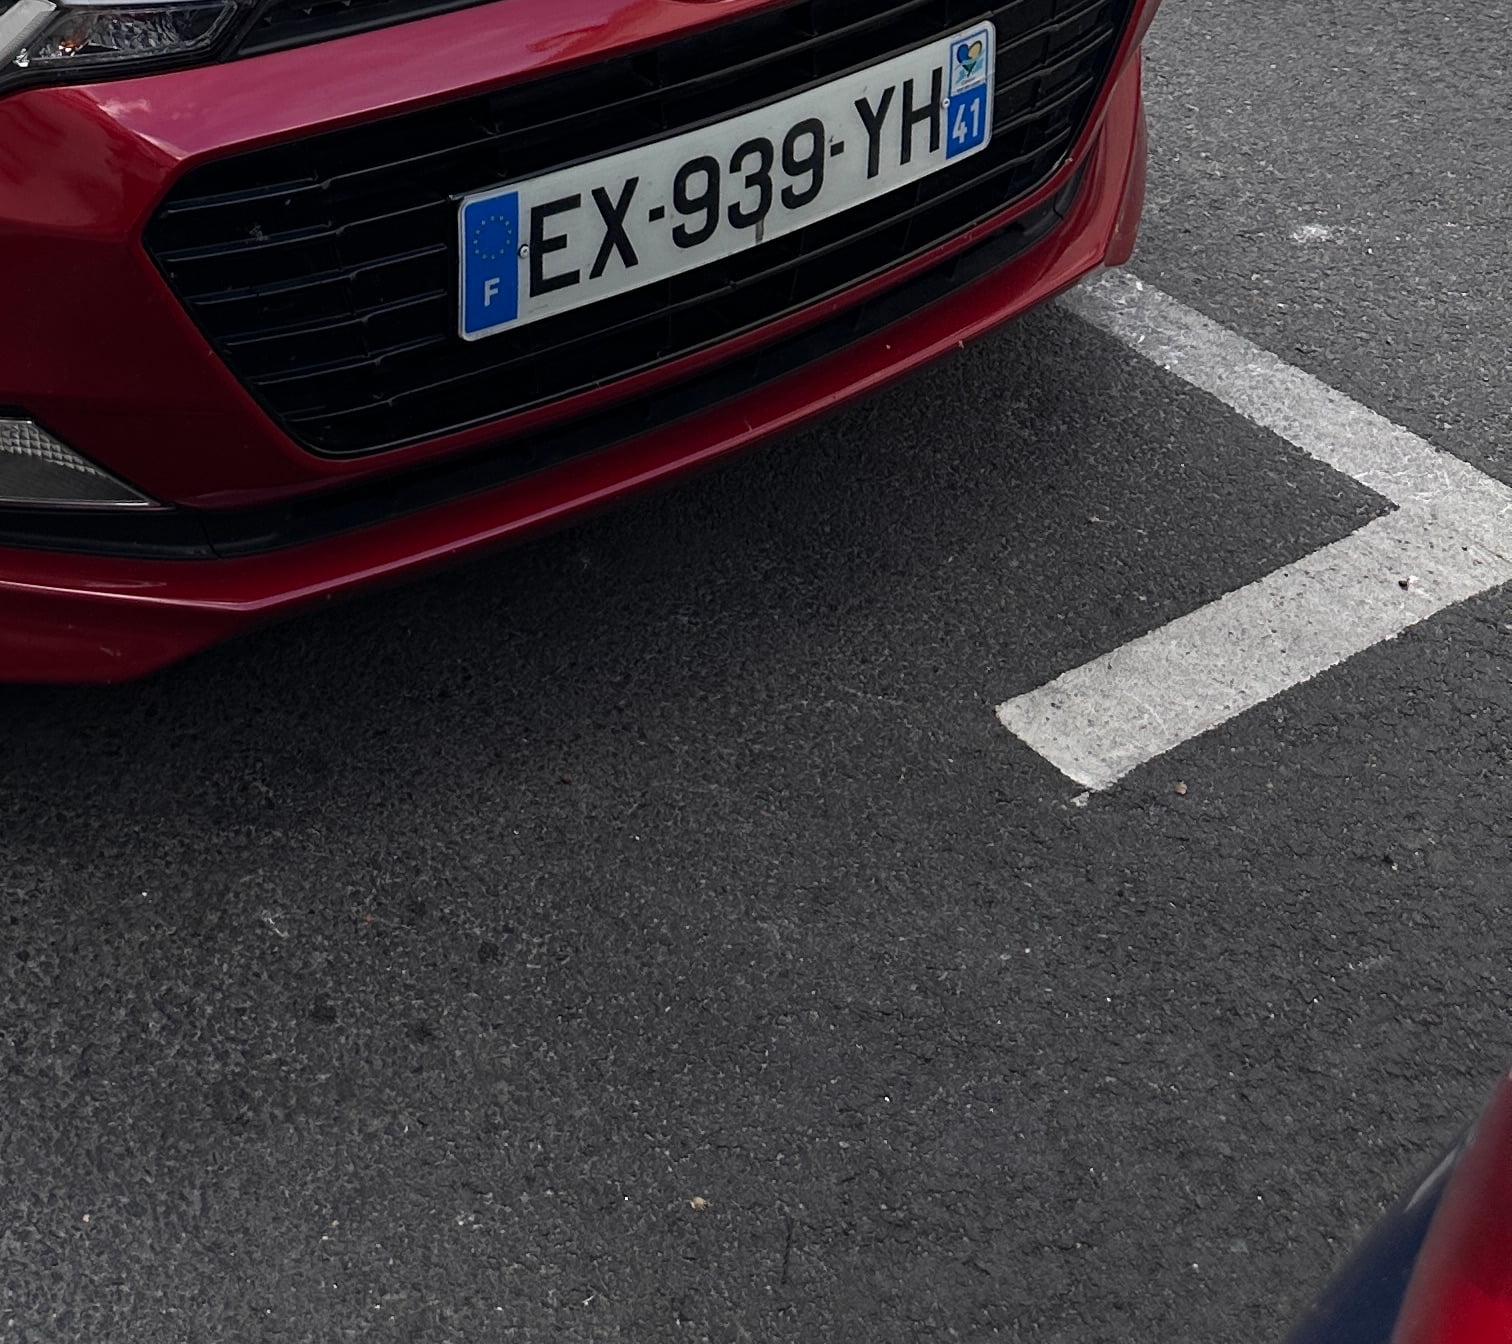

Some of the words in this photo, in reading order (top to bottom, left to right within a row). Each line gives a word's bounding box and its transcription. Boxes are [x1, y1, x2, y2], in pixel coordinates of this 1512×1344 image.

[483, 277, 500, 307] F
[529, 67, 942, 297] EX-939-YH
[952, 97, 981, 144] 41
